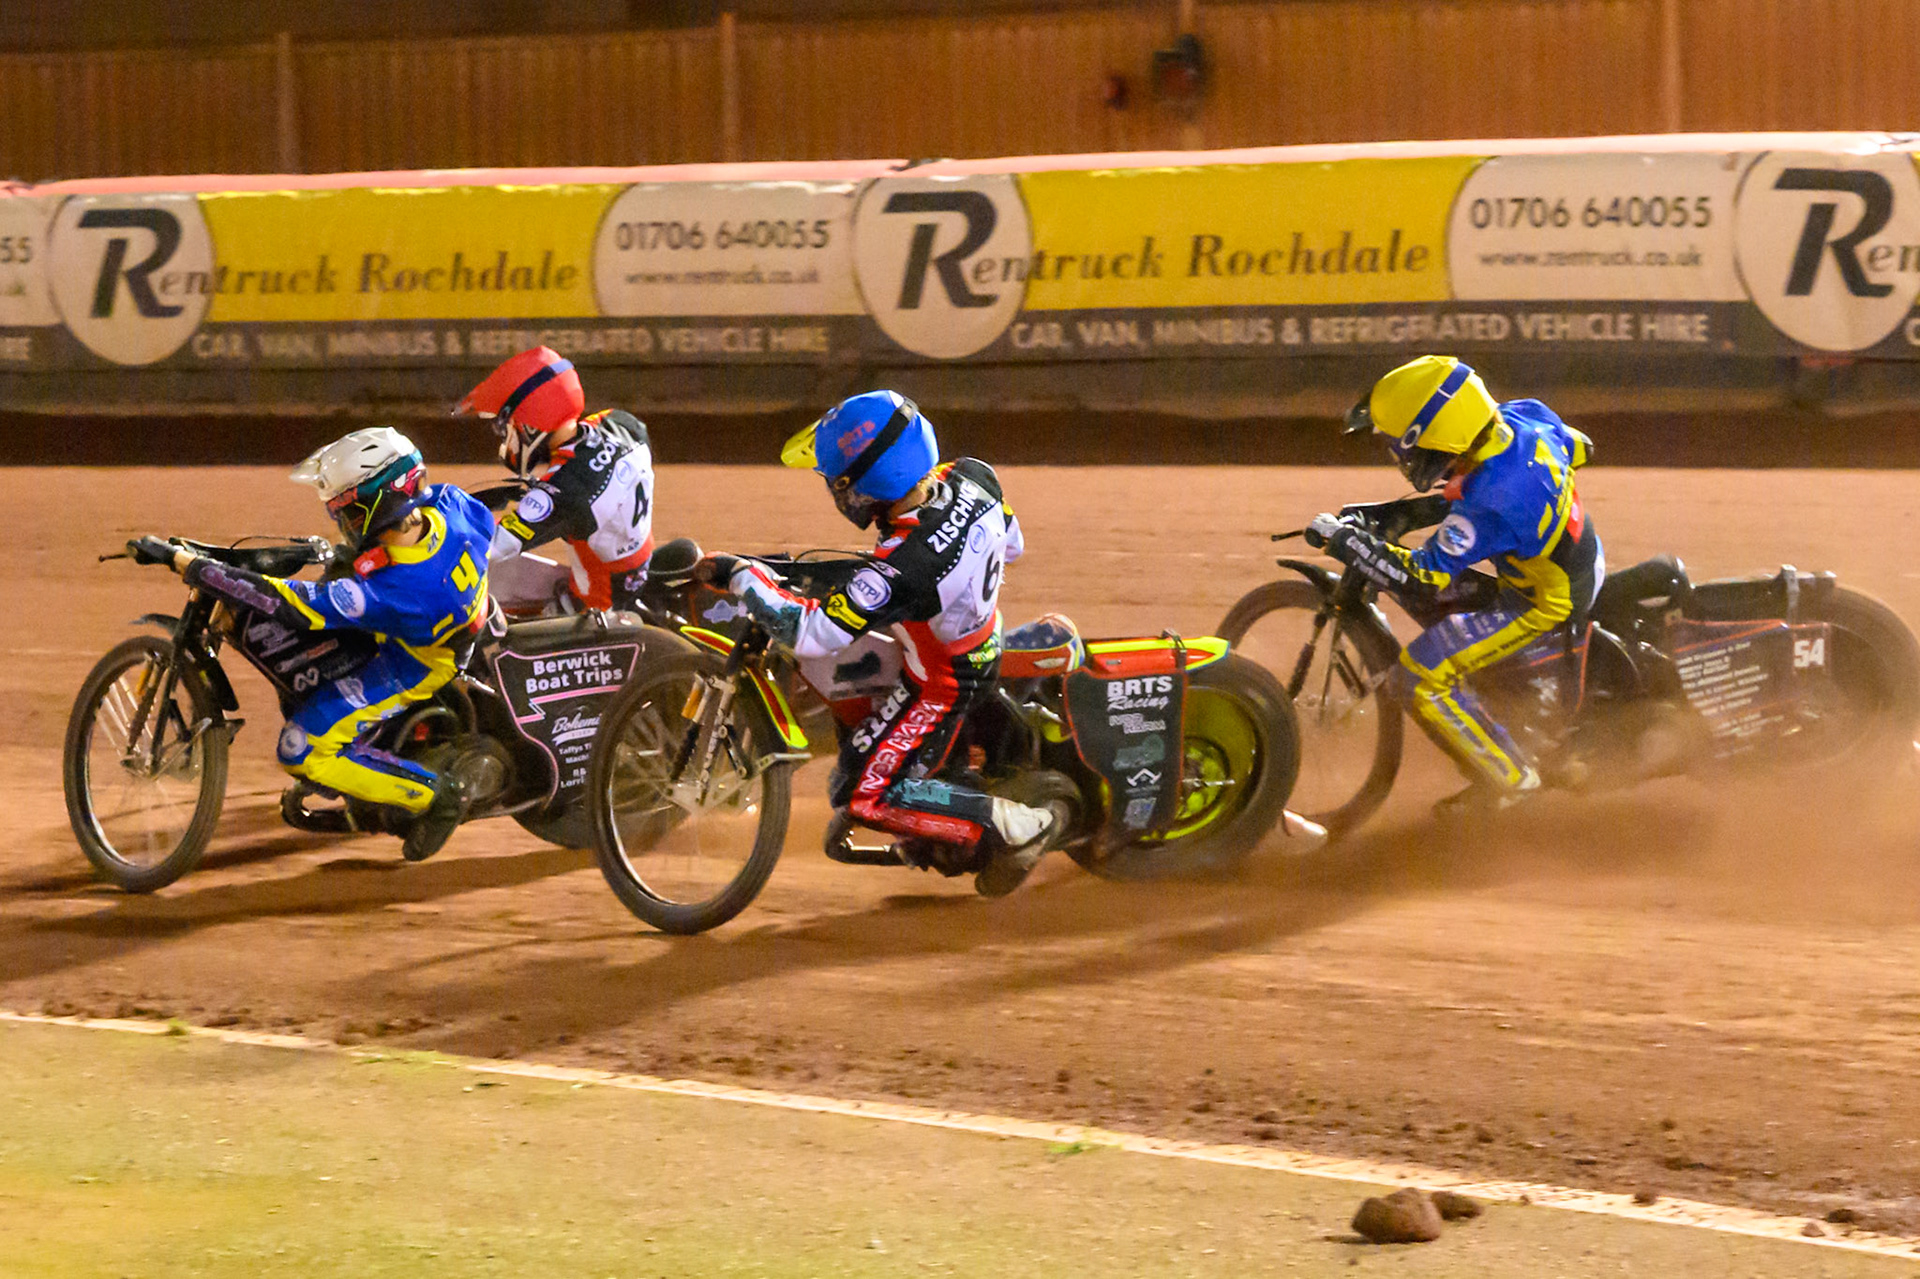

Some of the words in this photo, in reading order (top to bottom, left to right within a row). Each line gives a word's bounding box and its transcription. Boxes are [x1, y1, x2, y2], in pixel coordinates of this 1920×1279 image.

[1469, 197, 1571, 229] 01706
[1581, 196, 1712, 228] 640055
[616, 220, 706, 251] 01706
[715, 219, 830, 250] 640055
[882, 190, 1164, 310] Rentruck
[1187, 229, 1429, 279] Rochdale
[78, 208, 337, 318] Rentruck
[358, 250, 580, 295] Rochdale
[658, 327, 763, 353] VEHICLE
[769, 326, 829, 352] HIRE
[1153, 317, 1274, 345] MINIBUS
[1281, 316, 1301, 344] &
[1310, 313, 1510, 343] REFRIGERATED
[1516, 312, 1632, 342] VEHICLE
[1640, 312, 1709, 342] HIRE
[852, 578, 882, 602] ATPI
[982, 551, 1001, 602] 6
[533, 651, 612, 676] Berwick
[1793, 638, 1826, 668] 54
[526, 675, 570, 694] Boat
[574, 667, 623, 686] Trips
[1107, 675, 1173, 698] BRTS
[1107, 693, 1170, 712] Racing
